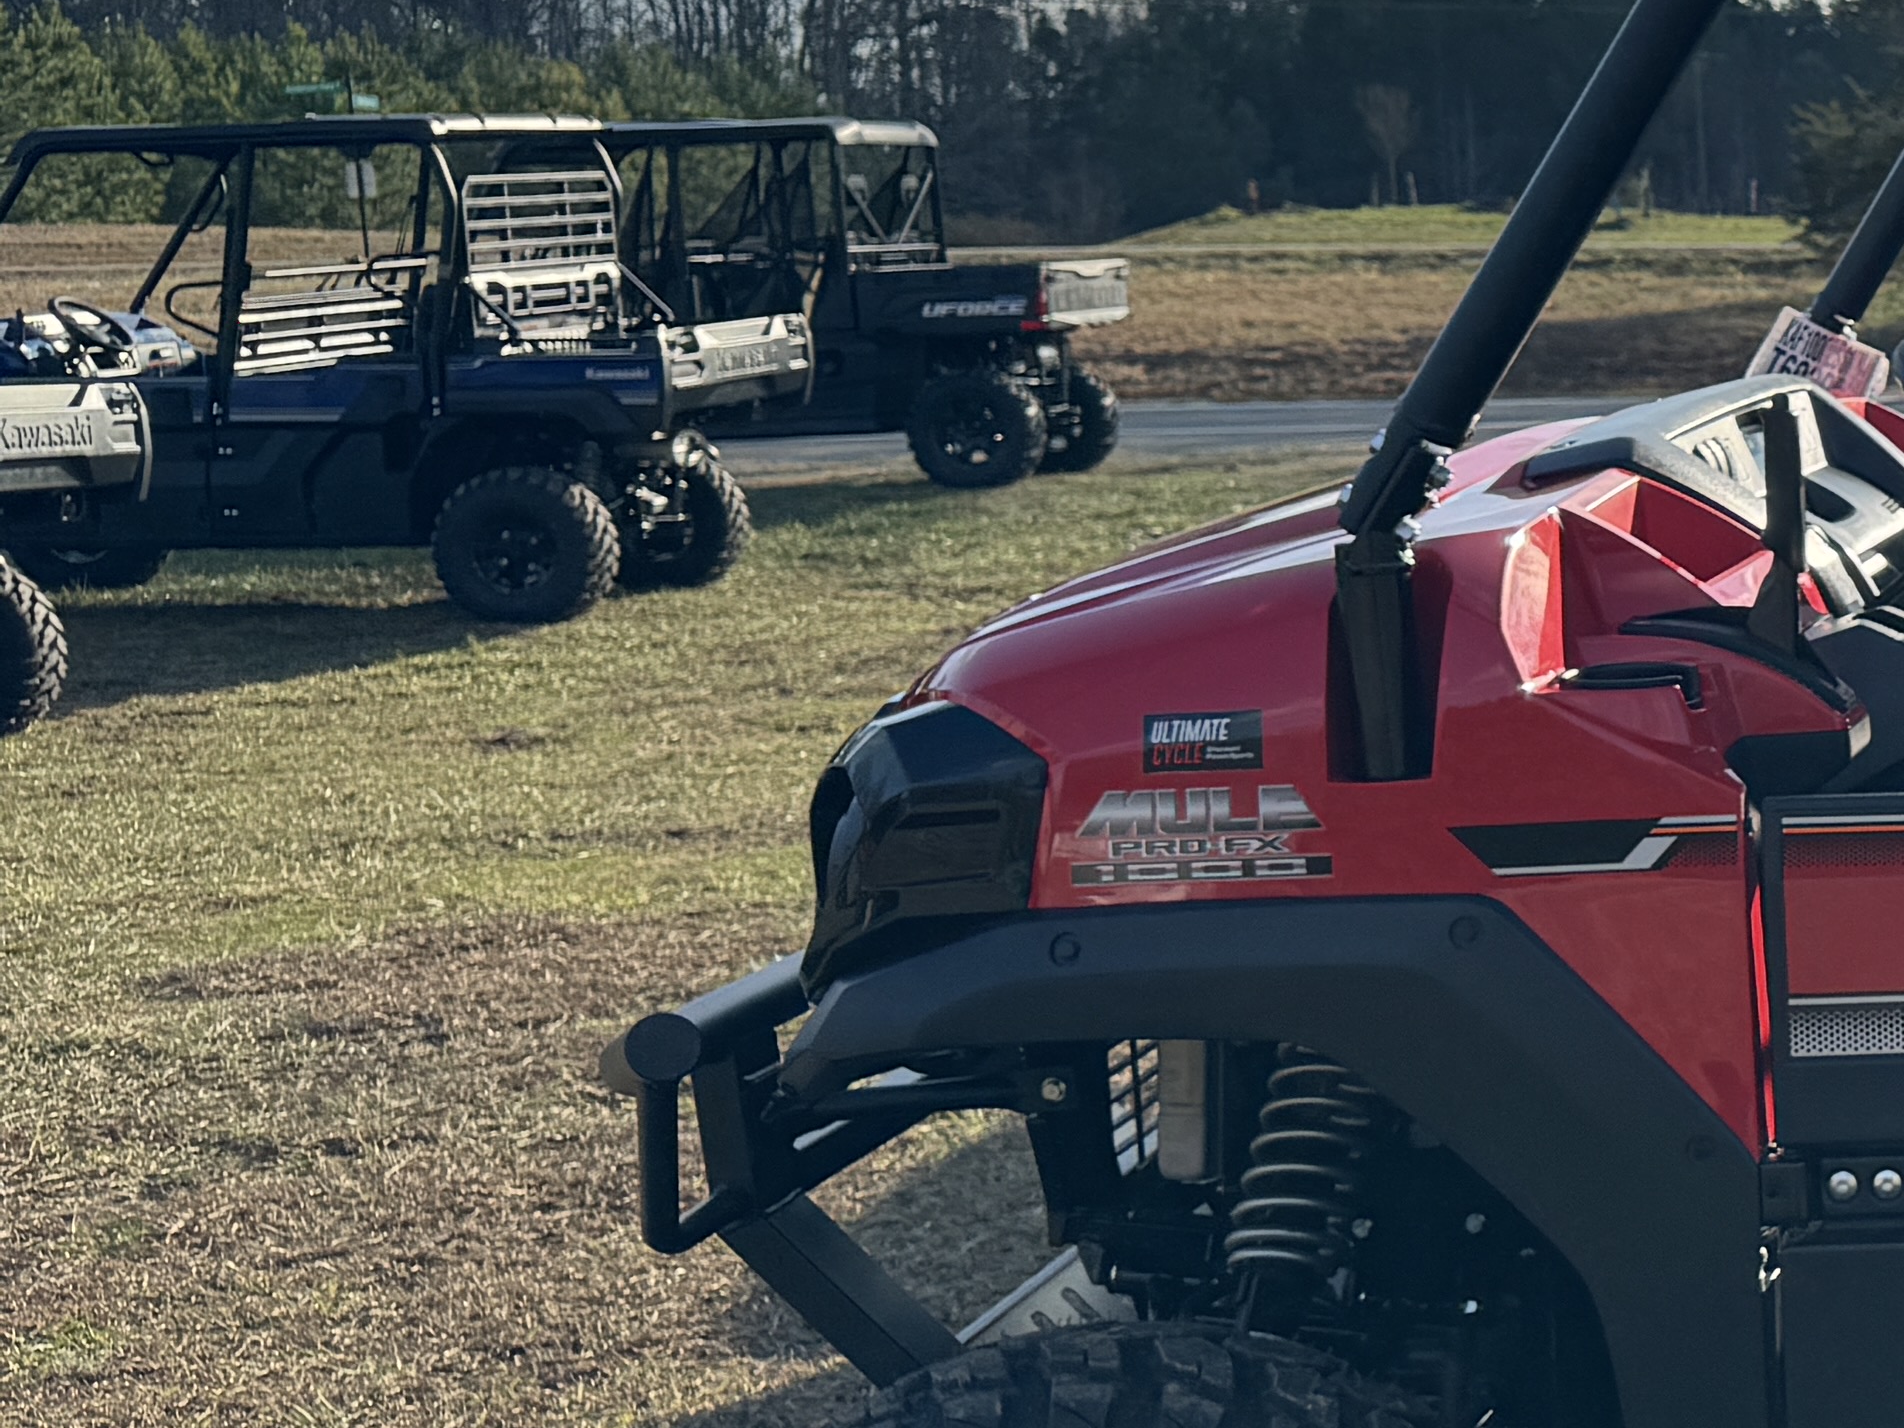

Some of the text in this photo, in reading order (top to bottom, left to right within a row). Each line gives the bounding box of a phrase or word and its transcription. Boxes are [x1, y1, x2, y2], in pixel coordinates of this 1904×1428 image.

[1150, 717, 1231, 744] ULTIMATE
[1153, 741, 1205, 766] CYCLE
[1076, 785, 1323, 836] MULE
[1096, 858, 1307, 881] 1000
